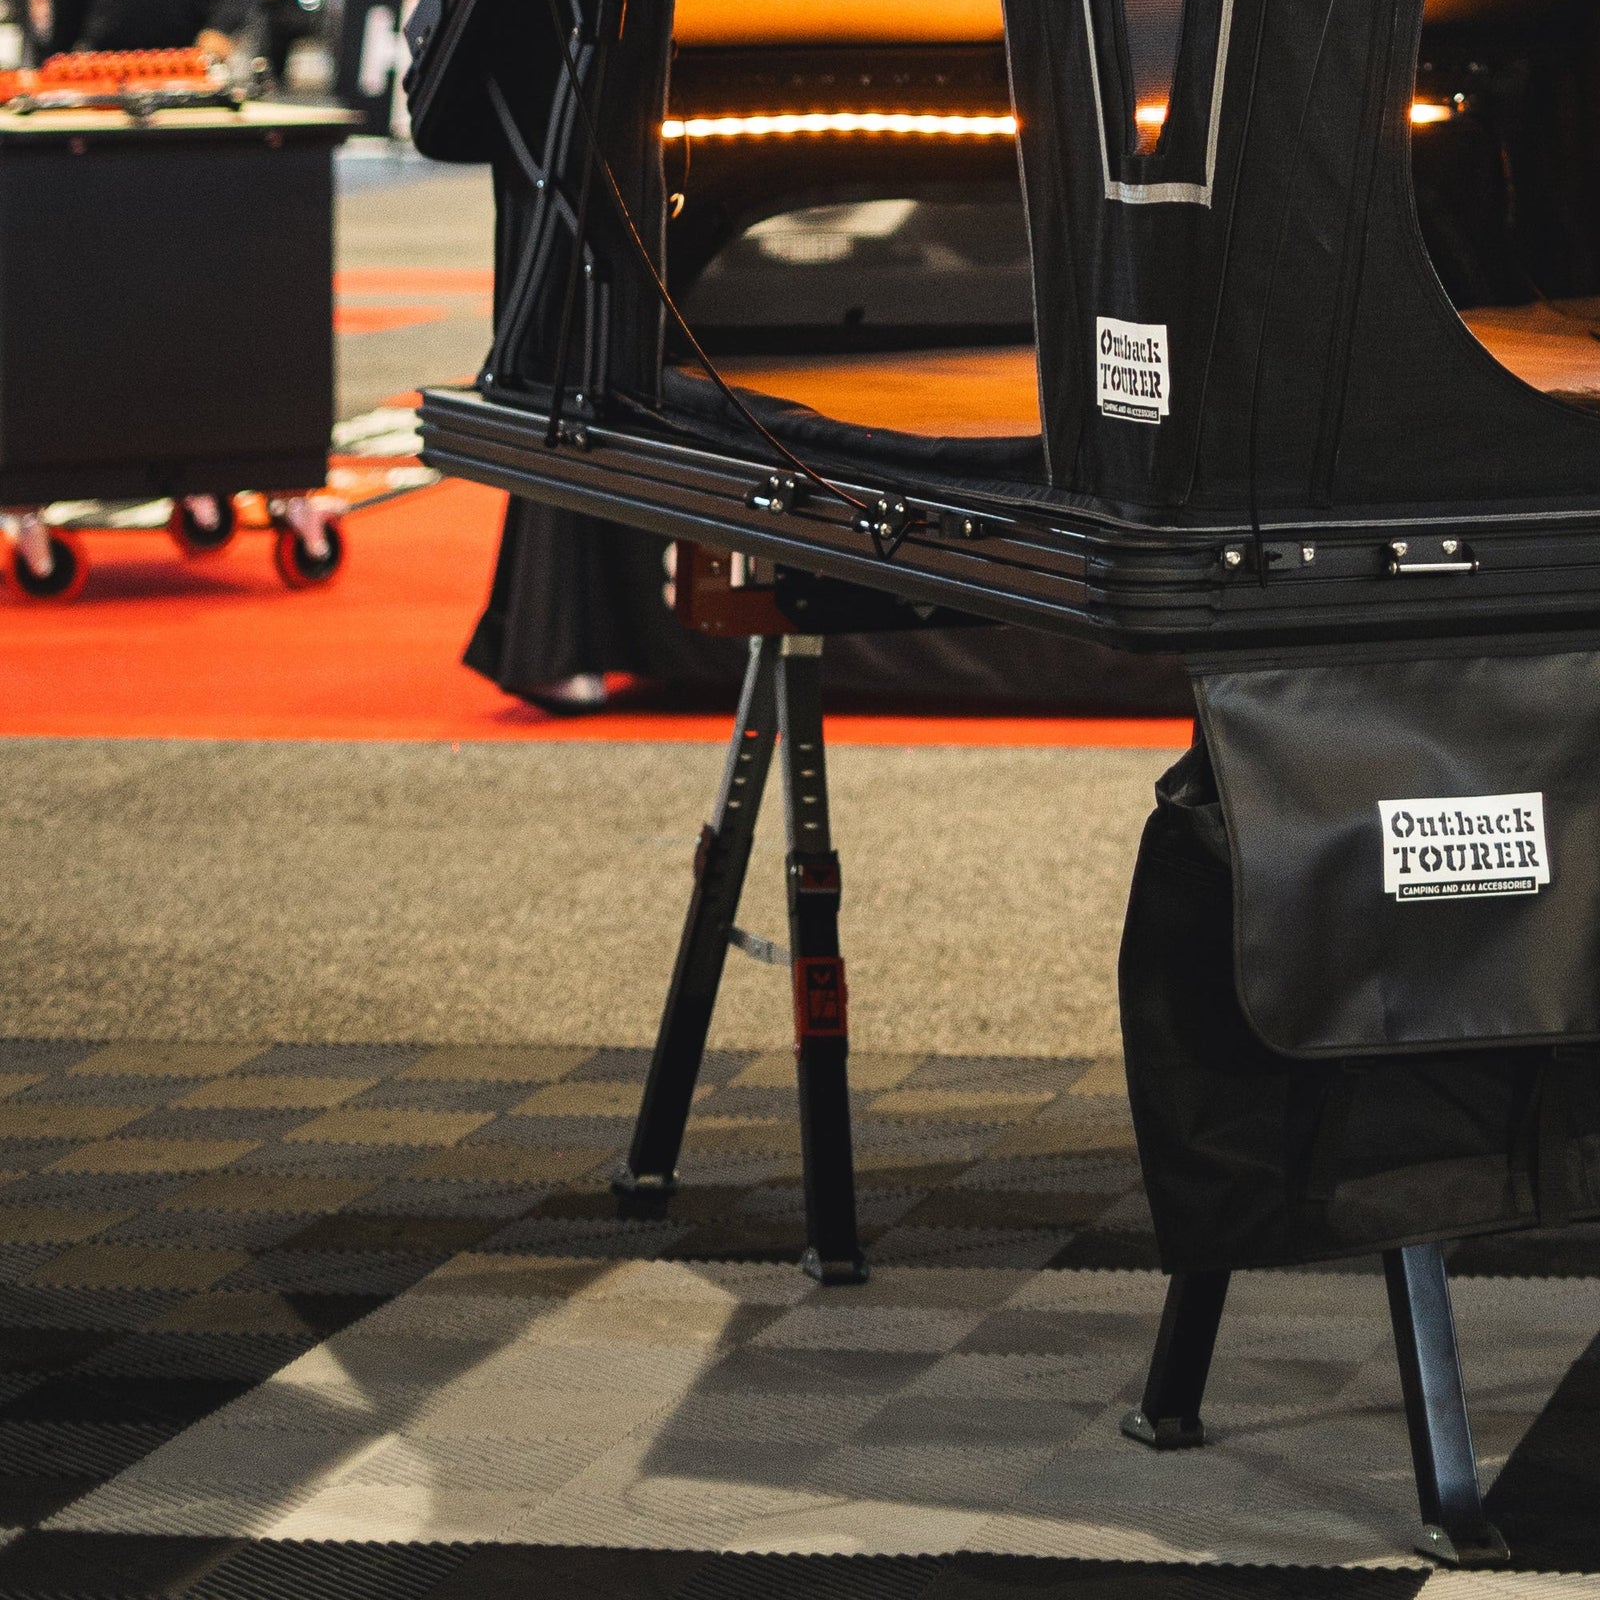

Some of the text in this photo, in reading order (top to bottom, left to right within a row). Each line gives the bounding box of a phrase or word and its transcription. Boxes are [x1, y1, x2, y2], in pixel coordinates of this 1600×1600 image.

[1100, 363, 1162, 399] TOURER
[1391, 808, 1535, 838] Outback
[1393, 840, 1540, 874] TOURER
[1403, 885, 1440, 895] CAMPING
[1442, 884, 1458, 893] AND
[1478, 880, 1532, 891] ACCESSORIES
